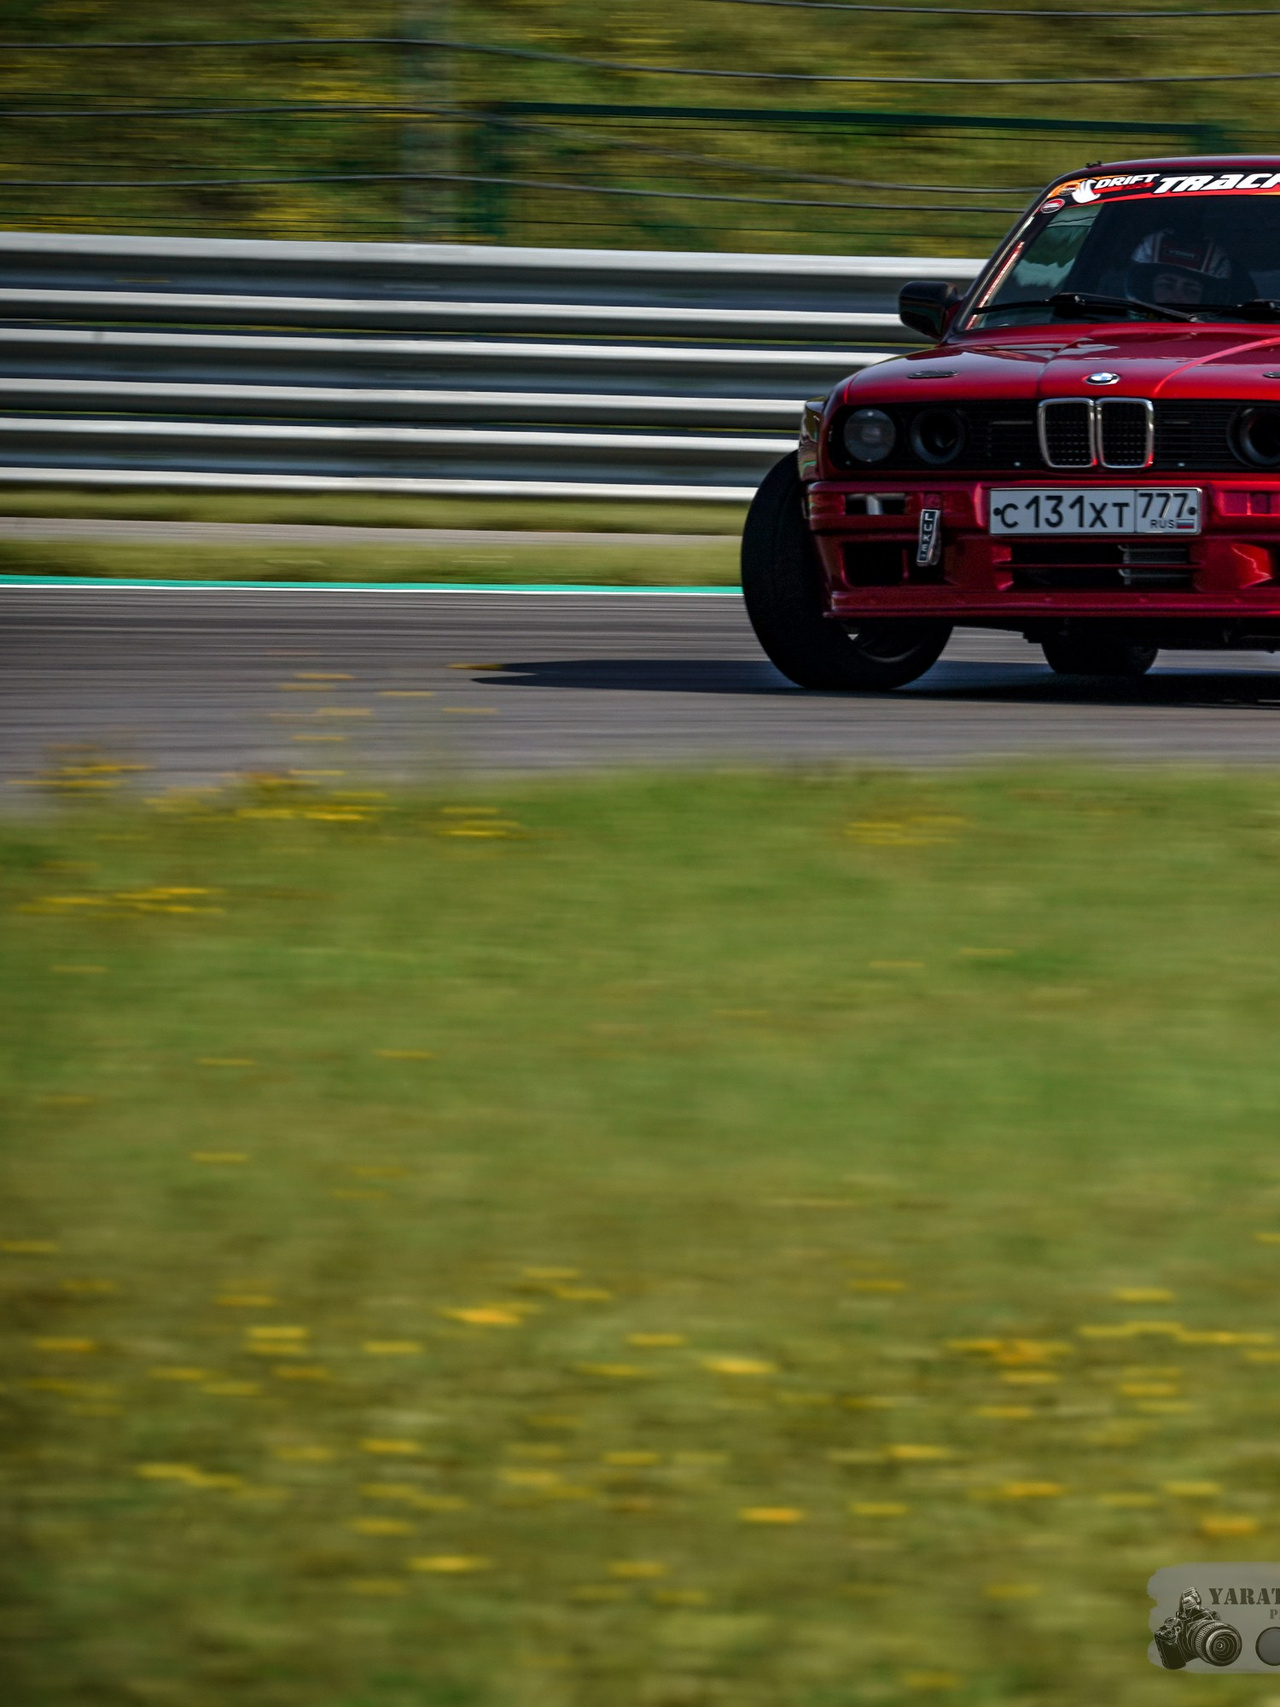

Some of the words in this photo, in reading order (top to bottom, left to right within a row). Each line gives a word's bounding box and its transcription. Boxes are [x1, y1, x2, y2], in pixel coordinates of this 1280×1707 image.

[1094, 174, 1160, 189] DRIFT
[1138, 493, 1189, 519] 777
[1150, 519, 1175, 529] RUS
